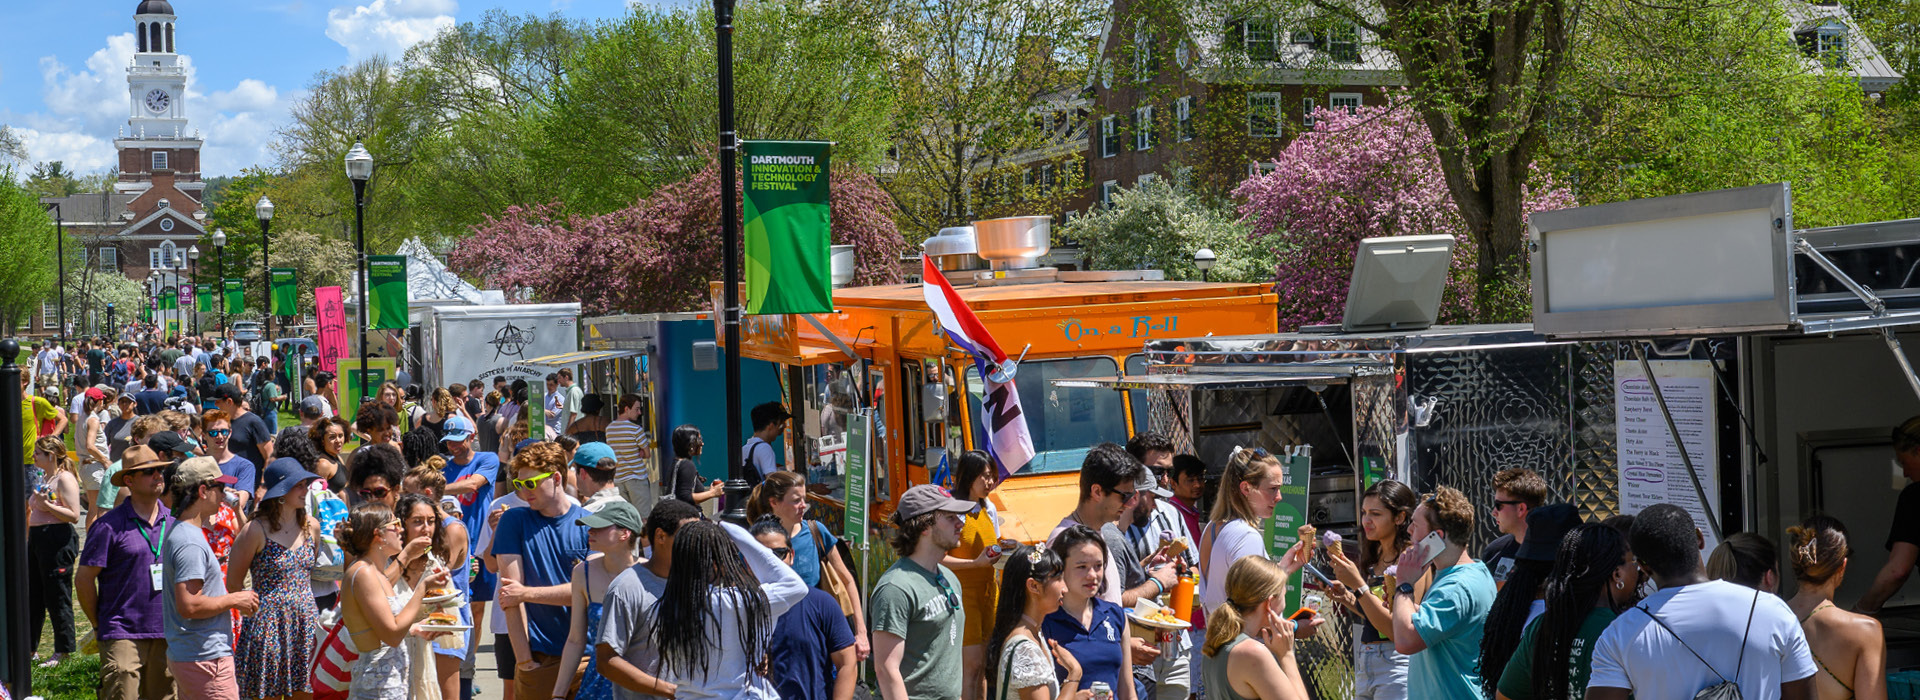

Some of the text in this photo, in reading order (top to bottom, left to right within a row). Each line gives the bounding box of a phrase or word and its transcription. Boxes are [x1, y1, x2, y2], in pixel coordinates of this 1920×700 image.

[751, 156, 814, 164] DARTMOUTH
[752, 173, 817, 182] TECHNOLOGY
[752, 182, 797, 190] FESTIVAL
[1064, 322, 1100, 341] On
[1108, 325, 1122, 334] a
[1127, 316, 1178, 338] Roll
[479, 367, 504, 380] SISTERS
[513, 366, 543, 377] ANARCHY
